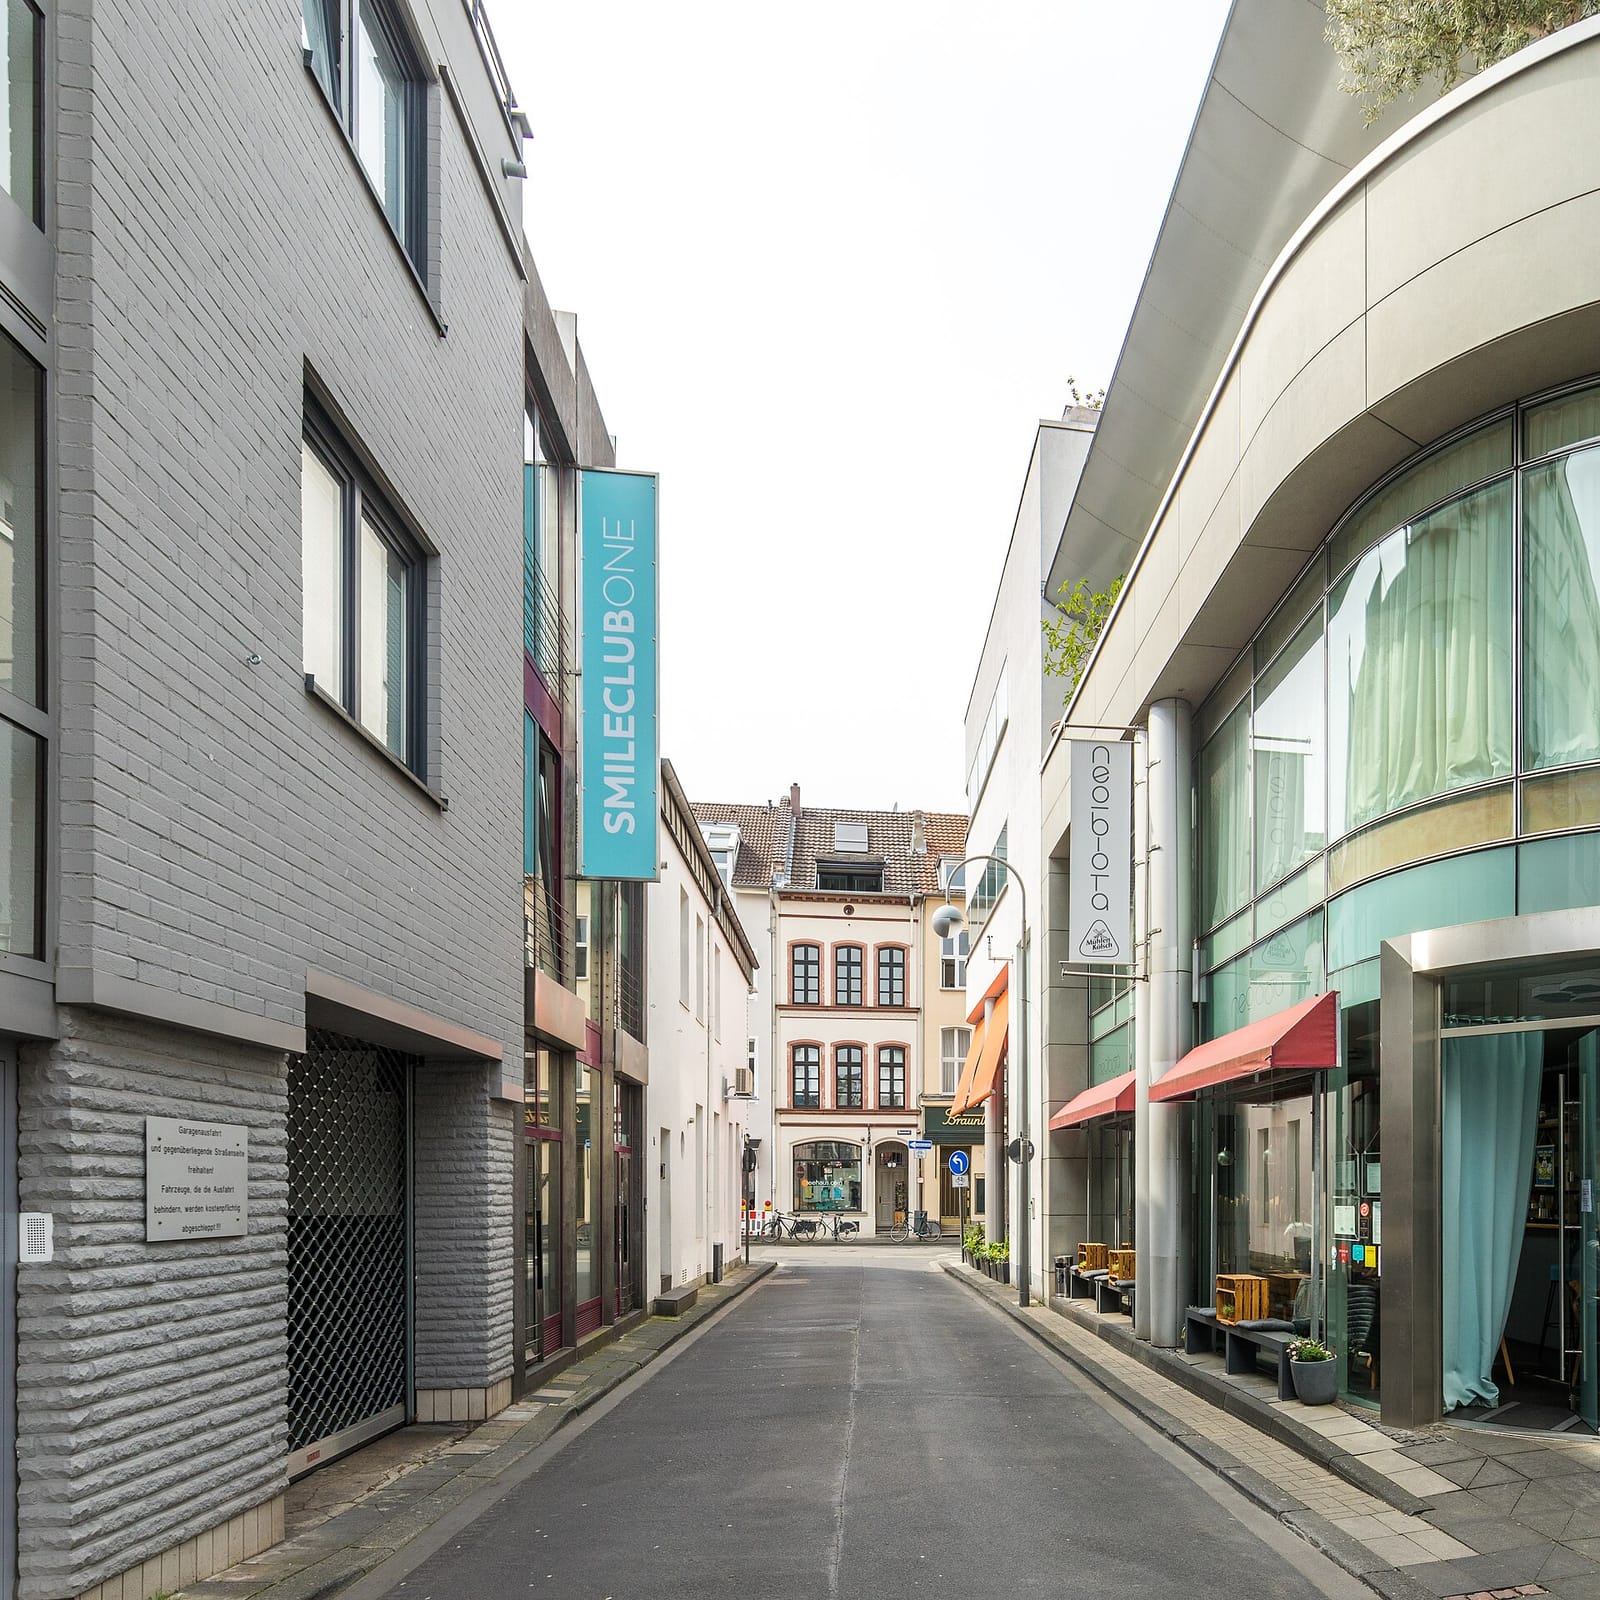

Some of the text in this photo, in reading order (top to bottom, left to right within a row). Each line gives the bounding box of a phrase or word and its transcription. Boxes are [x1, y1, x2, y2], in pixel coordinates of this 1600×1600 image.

[602, 516, 635, 836] SMILECLUBONE
[178, 1126, 222, 1137] Garagenausfahrt
[151, 1145, 245, 1157] und gegenüberliegende Straßenseite
[161, 1184, 192, 1195] Fahrzeuge,
[213, 1185, 235, 1193] Ausfahrt
[185, 1205, 204, 1213] werden
[205, 1203, 241, 1214] kostenpflichtig
